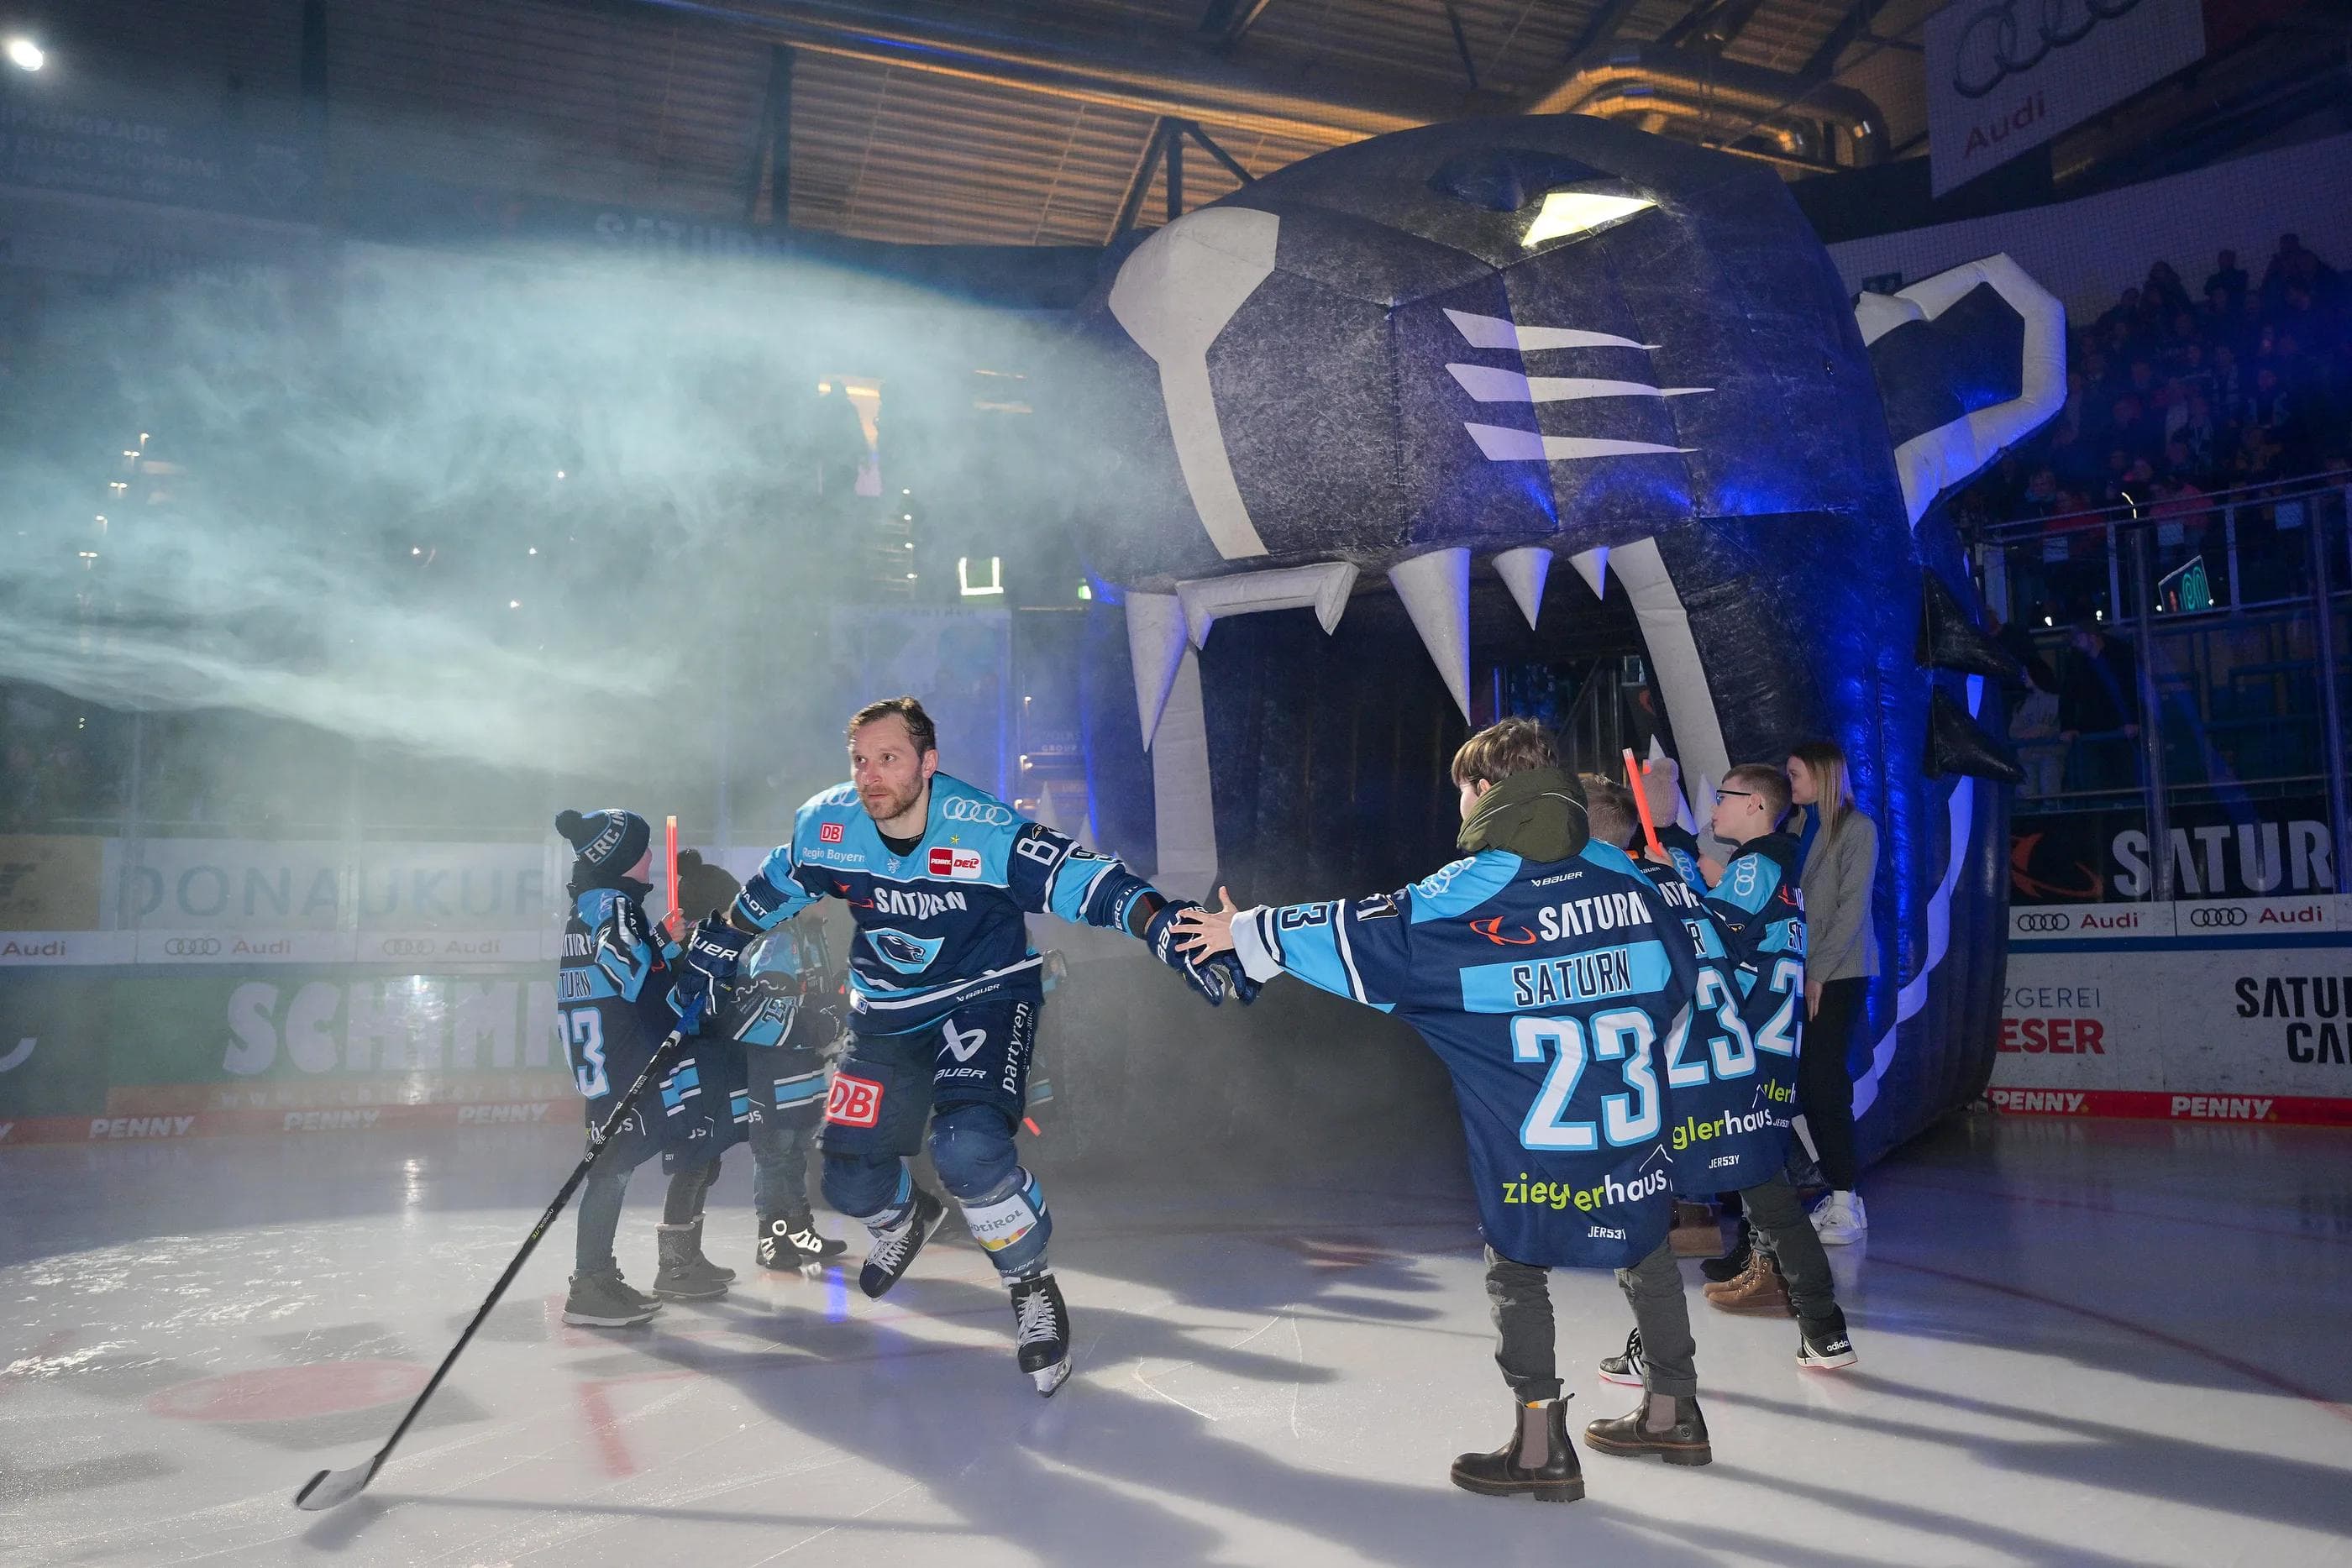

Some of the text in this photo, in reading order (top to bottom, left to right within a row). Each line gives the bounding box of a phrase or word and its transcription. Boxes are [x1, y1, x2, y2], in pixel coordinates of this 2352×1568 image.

[1962, 89, 2045, 160] Audi
[584, 828, 621, 864] ERC
[802, 847, 866, 863] Regio Bayern
[1541, 870, 1583, 886] BAUER
[874, 887, 968, 920] SATURN
[1537, 890, 1653, 941] SATURN
[2080, 912, 2139, 929] Audi
[2258, 905, 2323, 924] Audi
[2, 940, 67, 956] Audi
[232, 938, 292, 955] Audi
[444, 938, 501, 954] Audi
[1511, 947, 1632, 1008] SATURN
[965, 983, 1000, 999] BAUER
[1509, 1006, 1662, 1151] 23
[830, 1080, 874, 1119] DB
[1672, 1108, 1773, 1150] glerhaus
[1709, 1154, 1740, 1170] JER53Y
